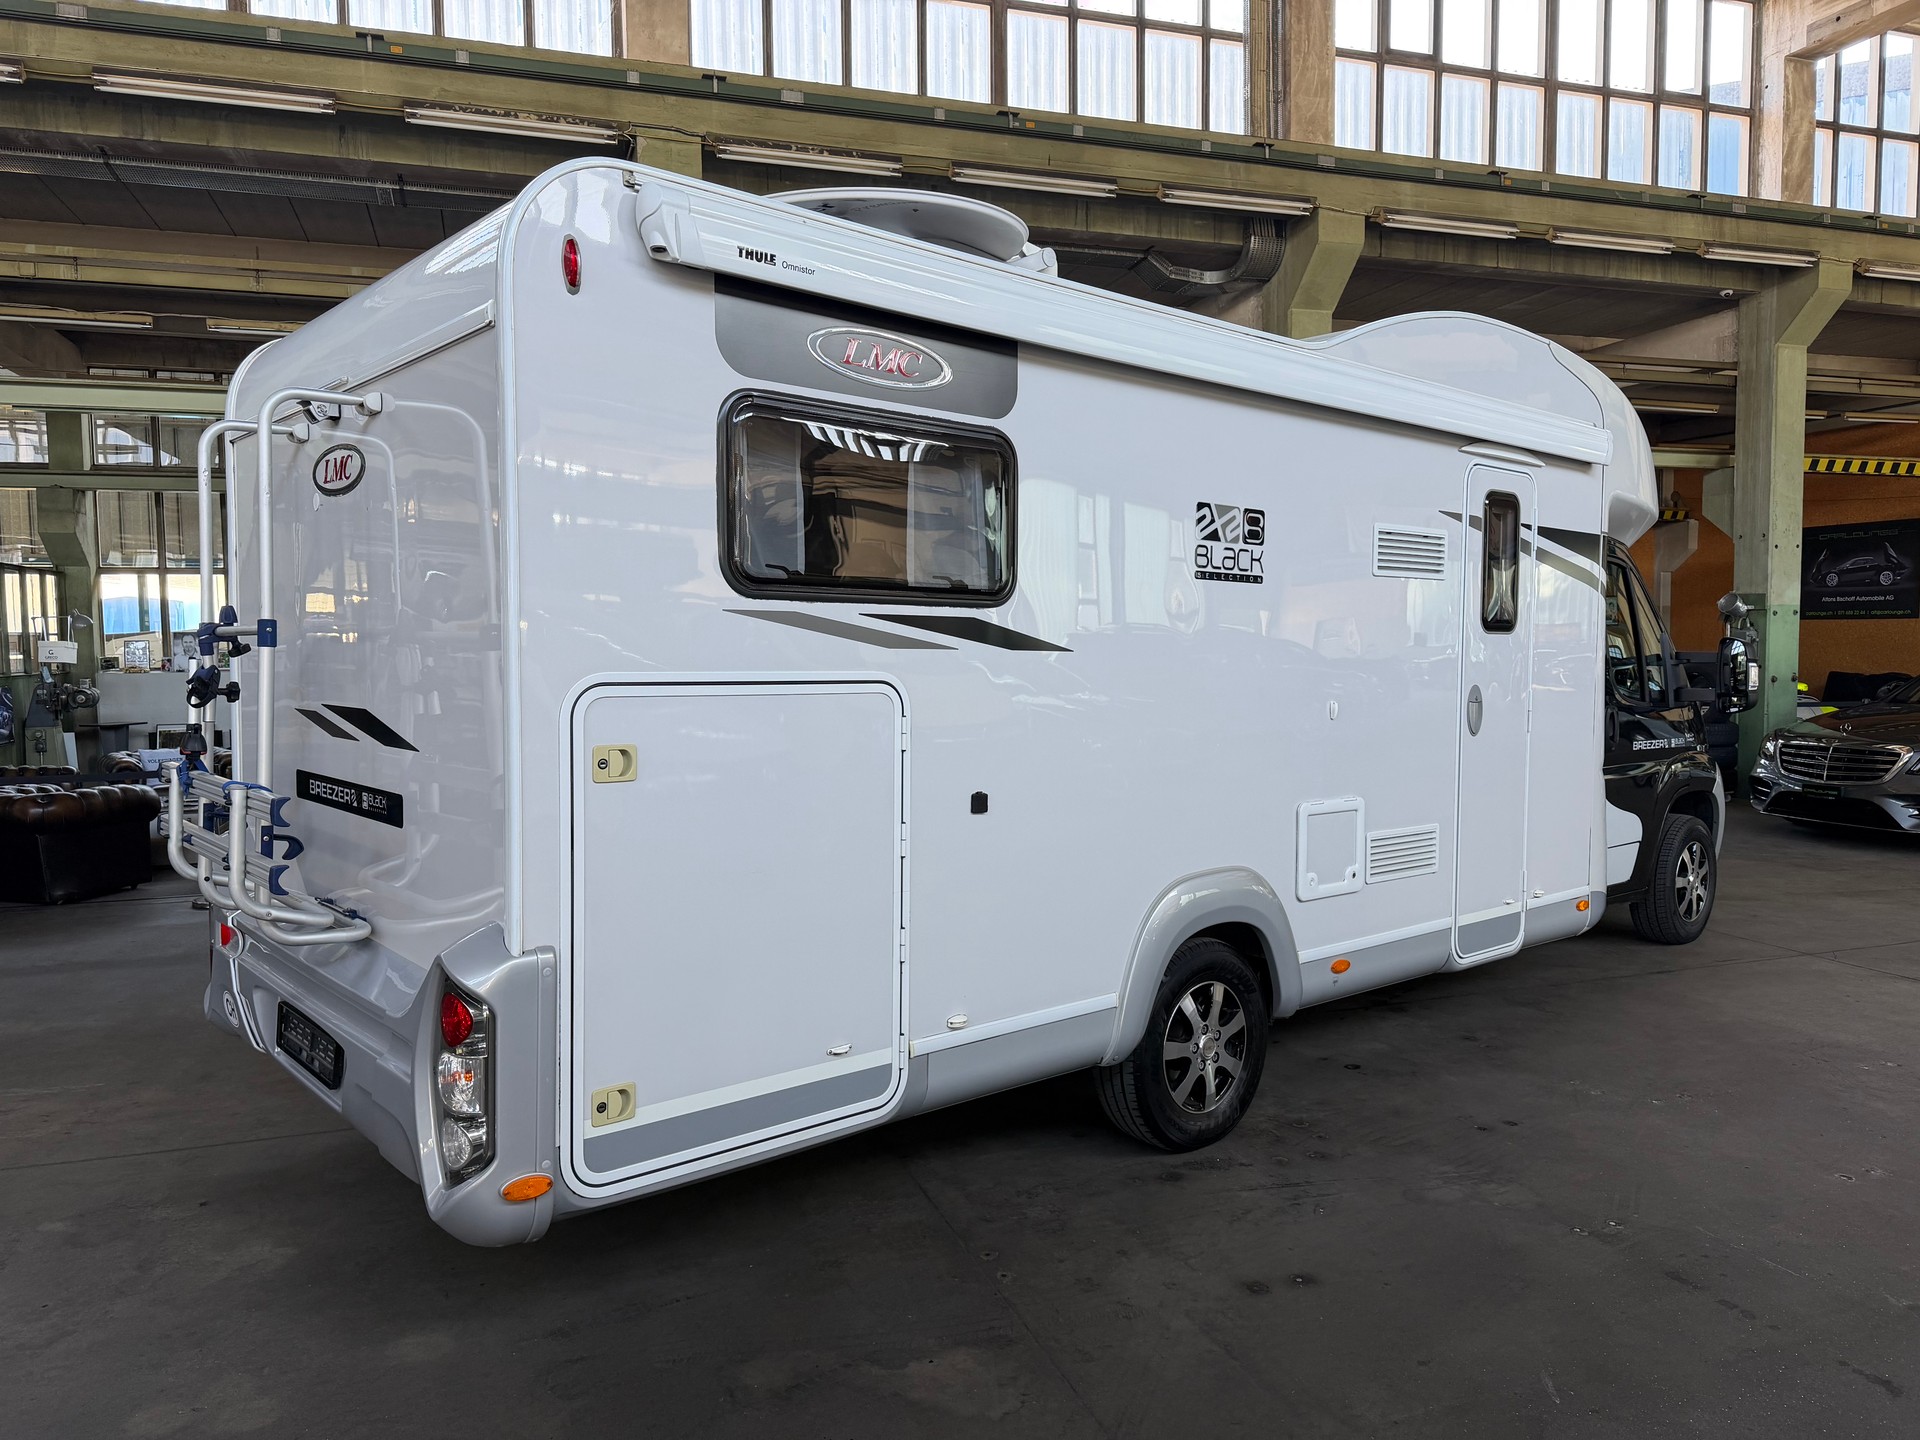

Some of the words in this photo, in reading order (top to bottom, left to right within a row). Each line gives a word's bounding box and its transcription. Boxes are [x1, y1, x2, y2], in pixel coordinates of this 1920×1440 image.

[737, 245, 777, 267] THULE
[781, 260, 816, 276] Omnistor
[840, 336, 924, 378] LMC
[323, 454, 353, 485] LMC
[1195, 572, 1263, 583] SELECTION
[1632, 739, 1664, 751] BREEZER
[309, 779, 351, 804] BREEZER
